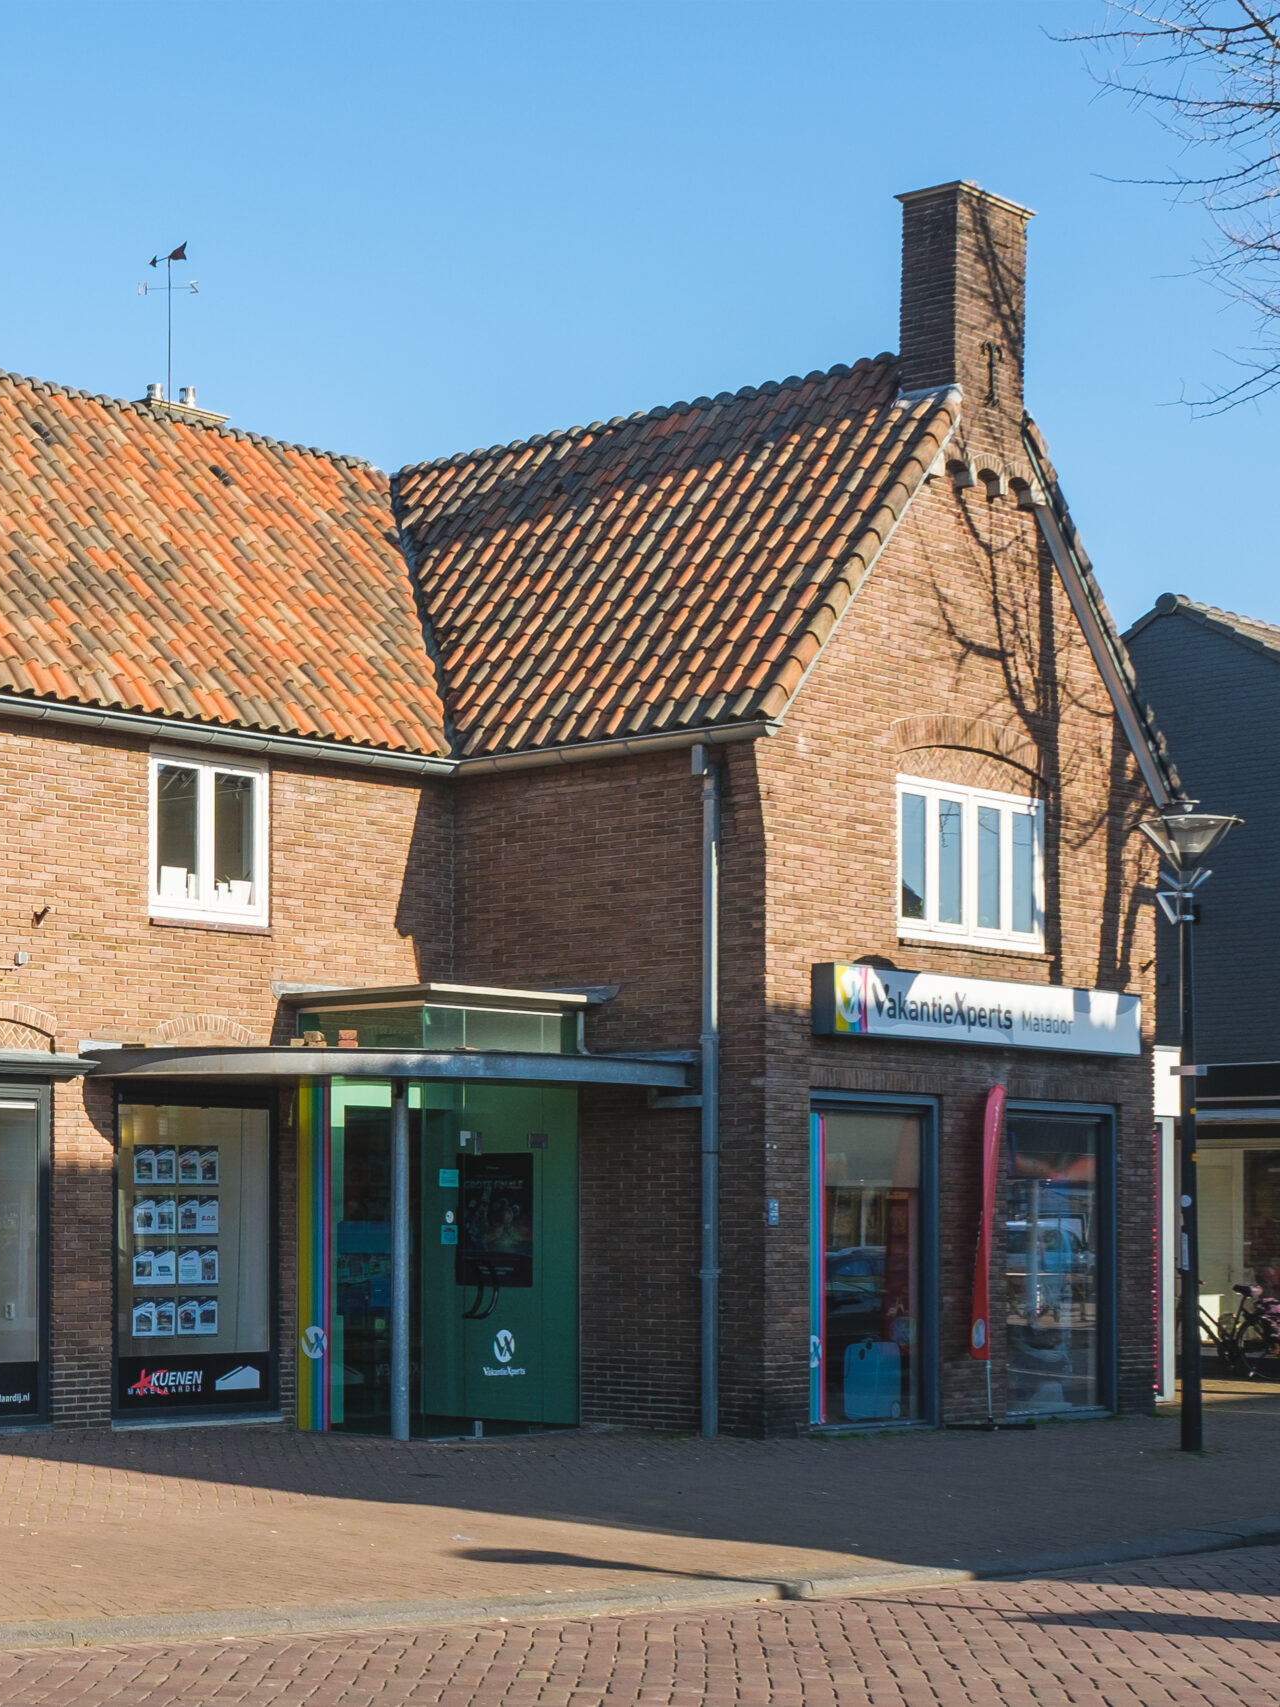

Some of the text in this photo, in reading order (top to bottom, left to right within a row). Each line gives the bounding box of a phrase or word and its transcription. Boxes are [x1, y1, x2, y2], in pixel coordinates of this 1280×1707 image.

[872, 983, 1074, 1035] VakantieXperts Matador
[150, 1370, 203, 1387] KUENEN
[127, 1385, 202, 1396] MAKELAARDIJ
